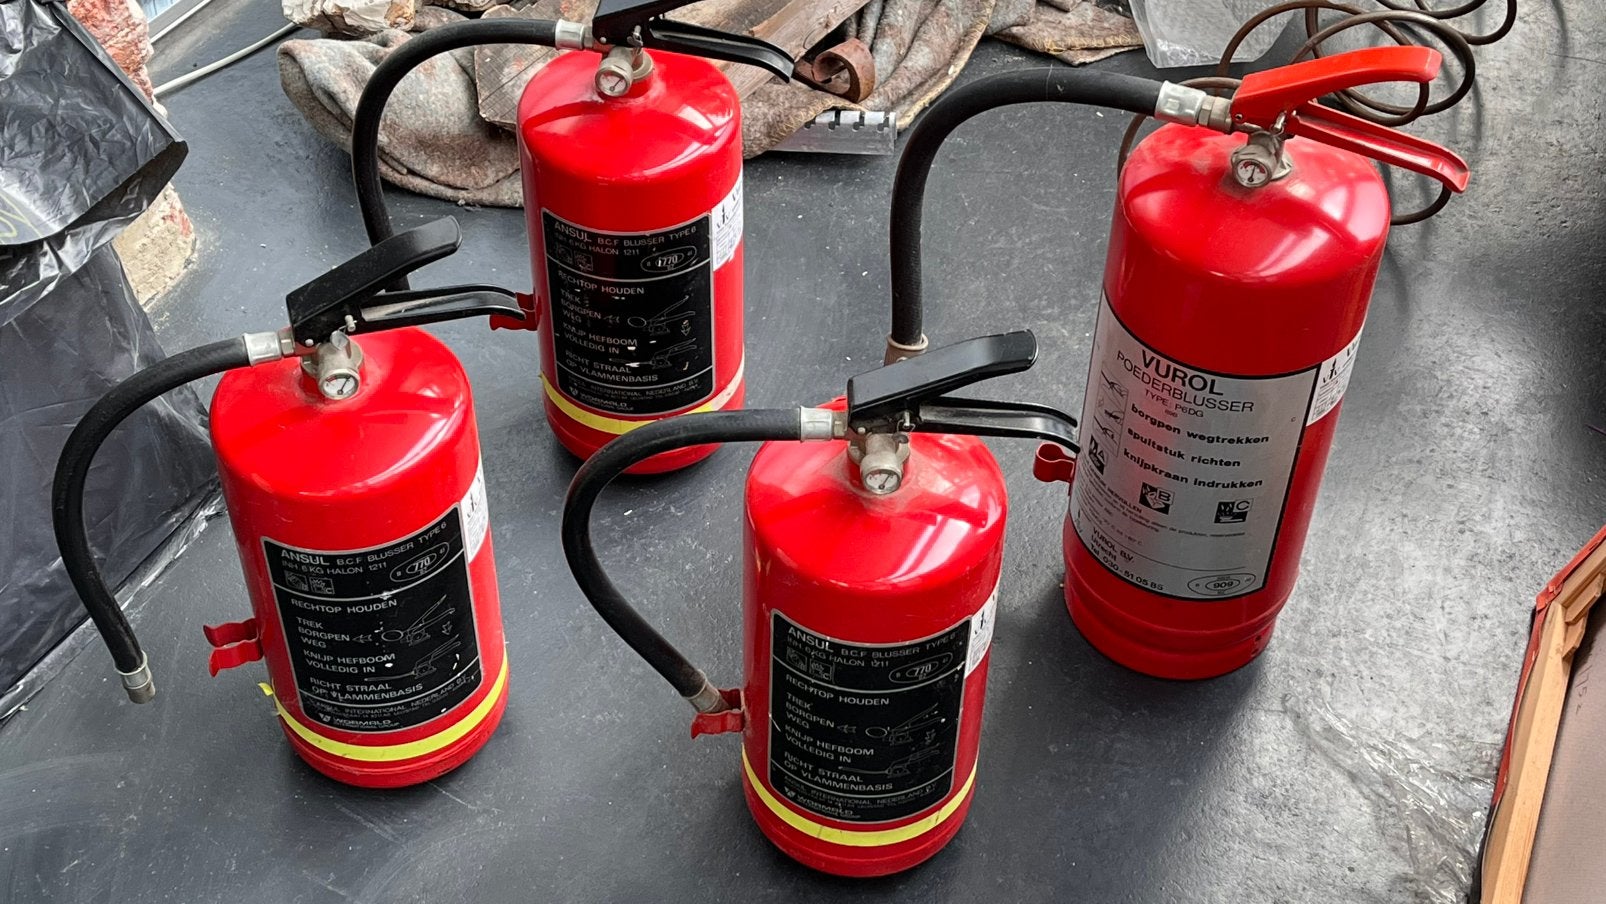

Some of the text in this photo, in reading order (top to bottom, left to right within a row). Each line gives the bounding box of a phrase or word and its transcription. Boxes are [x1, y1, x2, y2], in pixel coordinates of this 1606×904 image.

[555, 222, 592, 242] ANSUL
[624, 236, 665, 247] BLUSSER
[669, 229, 690, 240] TYPE
[589, 245, 619, 256] HALON
[558, 270, 644, 295] RECHTOP HOUDEN
[560, 288, 580, 304] TREK
[561, 298, 601, 319] BORGPEN
[564, 332, 605, 353] VOLLEDIG
[589, 333, 638, 347] HEFBOOM
[566, 350, 631, 374] RICHT STRAAL
[566, 359, 580, 370] OP
[581, 366, 658, 383] VLAMMENBASIS
[1142, 349, 1224, 396] VUROL
[1116, 350, 1254, 412] POEDERBLUSSER
[1174, 403, 1204, 417] P6DG
[1132, 403, 1269, 444] borgpen wegtrekken
[1127, 427, 1241, 467] spuitstuk richten
[1123, 448, 1188, 483] knijpkraan
[1194, 478, 1263, 489] indrukken
[1236, 500, 1250, 511] C
[282, 550, 330, 566] ANSUL
[368, 542, 414, 562] BLUSSER
[418, 526, 440, 543] TYPE
[1091, 535, 1117, 561] Utrecht
[1093, 526, 1117, 553] VUROL
[328, 566, 363, 574] HALON
[369, 561, 387, 571] 1211
[413, 557, 431, 571] 770
[1102, 556, 1119, 570] 030
[1124, 570, 1134, 580] 51
[1136, 574, 1148, 586] 05
[291, 598, 397, 613] RECHTOP HOUDEN
[296, 616, 323, 629] TREK
[298, 626, 350, 642] BORGPEN
[300, 637, 327, 648] WEG
[788, 626, 834, 652] ANSUL
[872, 647, 920, 659] BLUSSER
[303, 650, 396, 665] KNIJP HEFBOOM
[305, 659, 358, 673] VOLLEDIG
[829, 655, 865, 668] HALON
[913, 664, 932, 676] 770
[310, 677, 392, 692] RICHT STRAAL
[312, 683, 423, 701] OP VLAMMENBASIS
[786, 674, 890, 706] RECHTOP HOUDEN
[786, 693, 812, 710] TREK
[785, 702, 835, 728] BORGPEN
[786, 711, 810, 730] WEG
[785, 724, 874, 756] KNIJP HEFBOOM
[785, 734, 851, 763] VOLLEDIG IN
[784, 751, 863, 782] RICHT STRAAL
[784, 760, 798, 772] OP
[801, 770, 893, 792] VLAMMENBASIS
